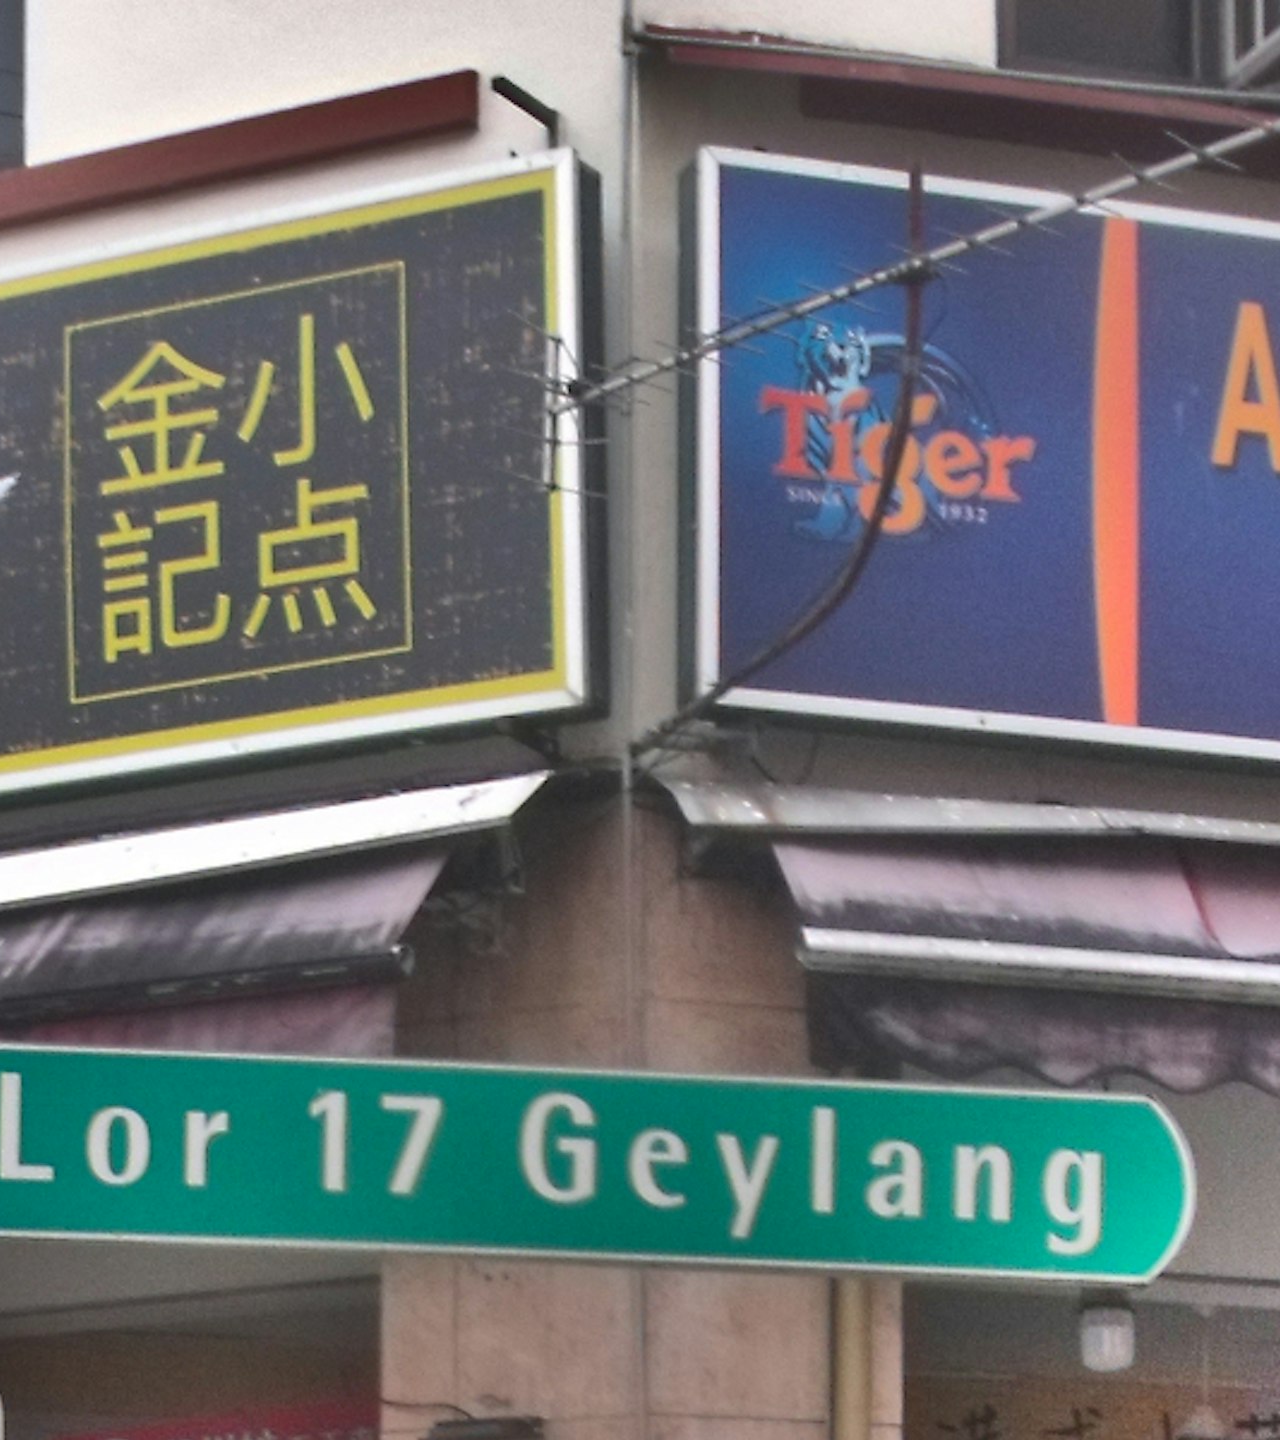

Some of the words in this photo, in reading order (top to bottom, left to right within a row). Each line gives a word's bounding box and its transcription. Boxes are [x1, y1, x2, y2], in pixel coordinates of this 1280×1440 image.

[757, 384, 1037, 535] Tiger
[307, 1089, 445, 1196] 17
[519, 1090, 1106, 1257] Geylang
